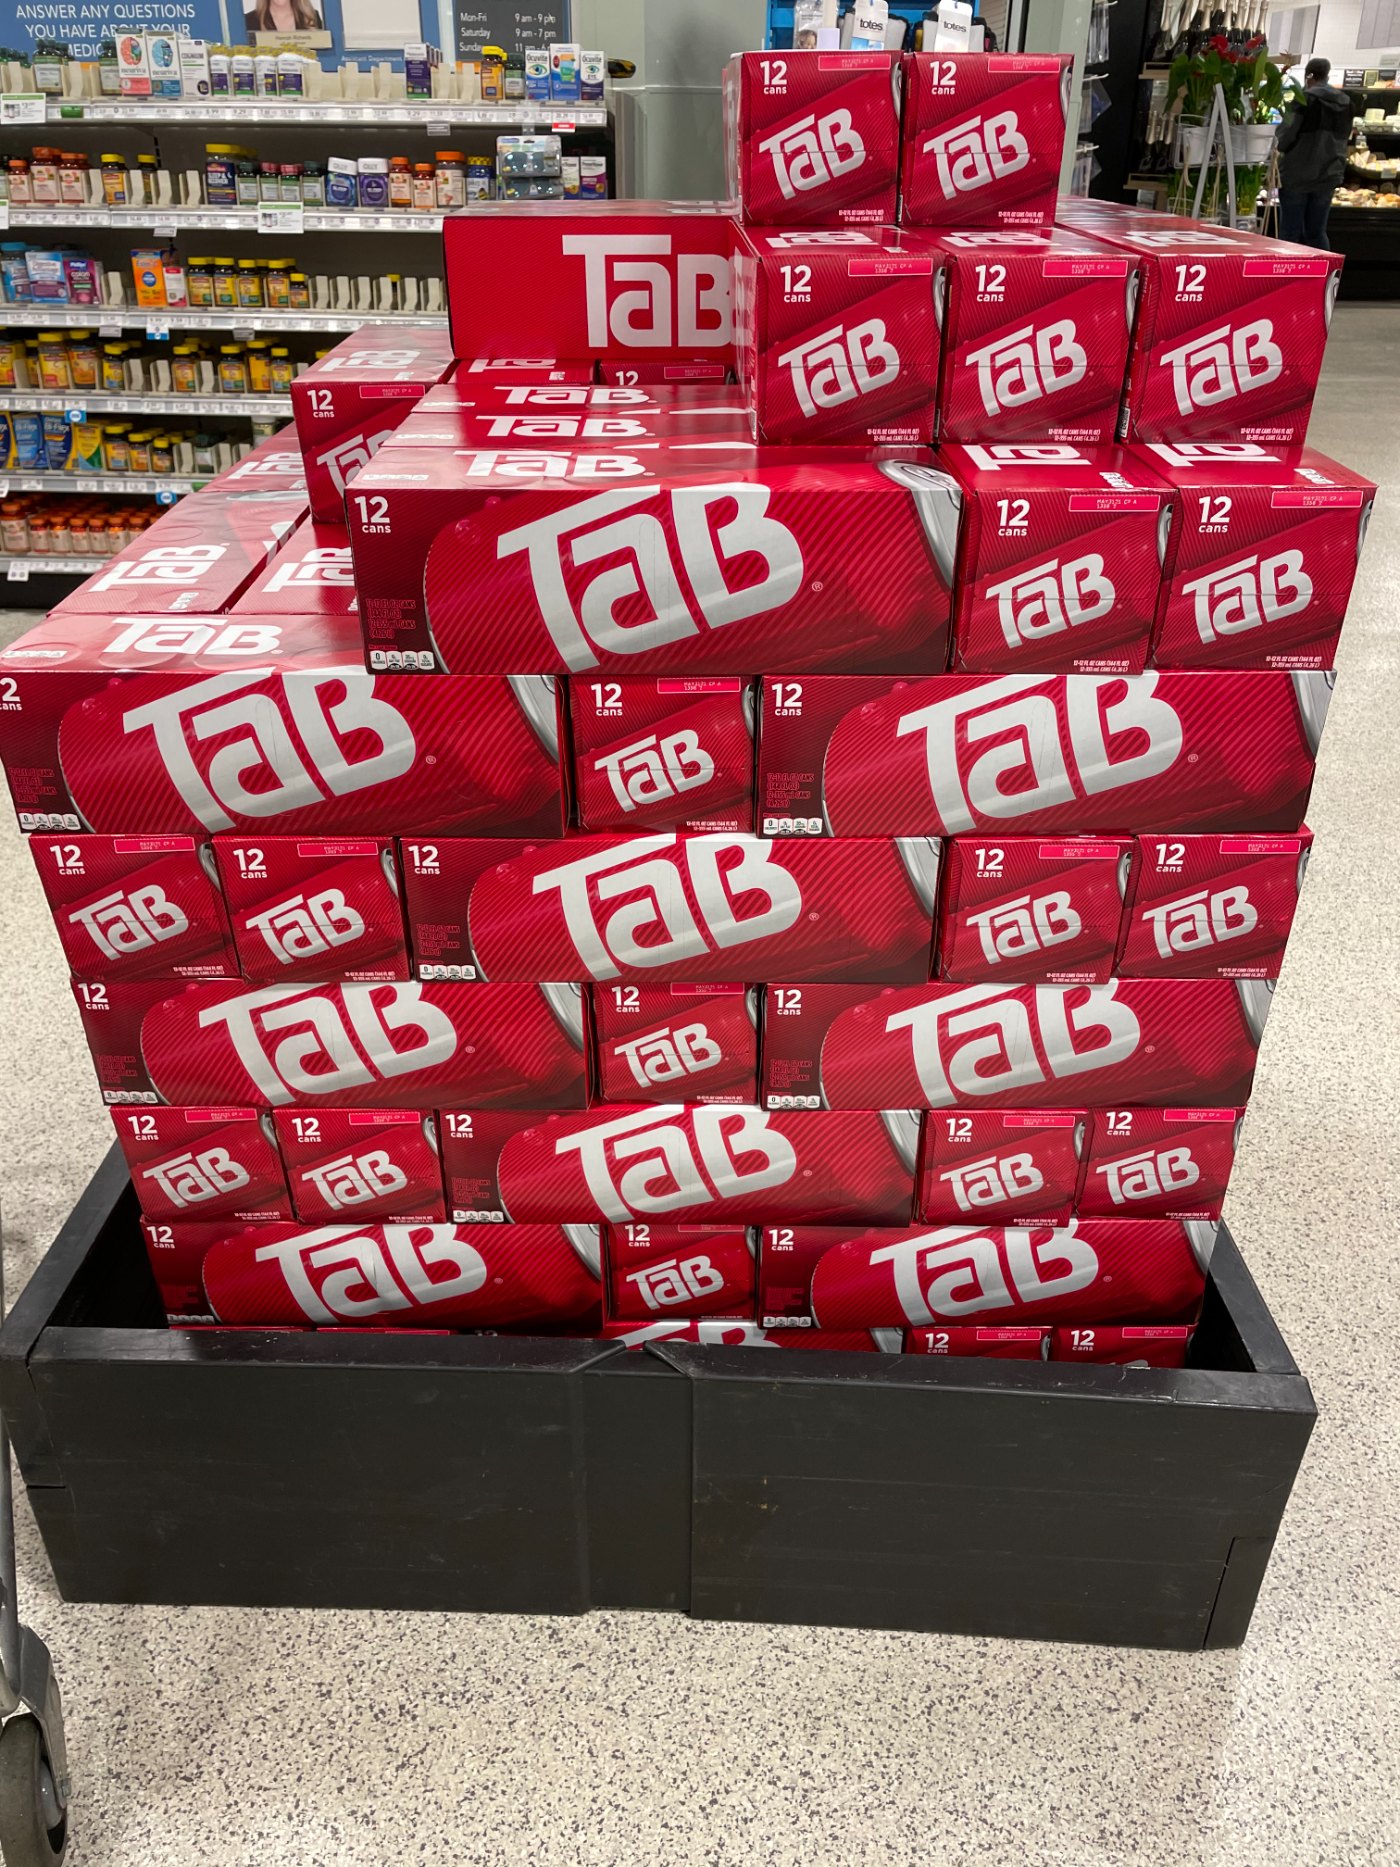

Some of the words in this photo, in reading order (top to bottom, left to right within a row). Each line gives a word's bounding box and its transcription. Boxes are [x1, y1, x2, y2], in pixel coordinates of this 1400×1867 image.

[16, 5, 77, 19] ANSWER
[80, 5, 109, 19] ANY
[114, 4, 196, 18] QUESTIONS
[460, 13, 488, 22] Mon-Fri
[514, 14, 521, 22] 9
[537, 14, 544, 23] 9
[25, 25, 56, 38] YOU
[60, 25, 97, 37] HAVE
[461, 28, 491, 39] Saturday
[515, 29, 521, 37] 9
[538, 29, 544, 38] 7
[544, 31, 556, 40] pm
[859, 18, 883, 31] totes
[943, 20, 967, 33] totes
[459, 42, 484, 52] Sunda
[514, 44, 523, 52] 11
[526, 54, 548, 63] Ocuvite
[582, 56, 602, 64] Ocuvite
[760, 61, 787, 85] 12
[930, 61, 956, 85] 12
[763, 86, 788, 95] cans
[931, 87, 956, 95] cans
[759, 109, 866, 199] TaB
[923, 111, 1030, 199] TaB
[781, 265, 811, 292] 12
[976, 265, 1006, 291] 12
[1176, 265, 1206, 291] 12
[562, 235, 738, 348] TaB
[783, 293, 811, 303] cans
[976, 293, 1004, 303] cans
[1174, 293, 1203, 302] cans
[778, 319, 900, 417] TaB
[966, 319, 1087, 416] TaB
[1160, 319, 1282, 416] TaB
[616, 371, 638, 385] 12
[307, 390, 333, 410] 12
[494, 387, 649, 404] TaB
[312, 410, 335, 418] cans
[476, 416, 647, 437] TaB
[453, 450, 645, 477] TaB
[962, 445, 1091, 470] Ta
[1126, 444, 1281, 466] Ta
[355, 496, 390, 523] 12
[997, 499, 1029, 526] 12
[1199, 496, 1231, 522] 12
[361, 524, 392, 534] cans
[997, 528, 1028, 537] cans
[1198, 524, 1229, 533] cans
[497, 482, 803, 673] TaB
[986, 554, 1115, 648] TaB
[1182, 550, 1313, 643] TaB
[103, 617, 282, 655] TaB
[0, 678, 20, 701] 2
[591, 684, 622, 707] 12
[772, 683, 802, 707] 12
[595, 708, 623, 717] cans
[774, 708, 802, 717] cans
[123, 666, 416, 833] TaB
[896, 670, 1183, 835] TaB
[595, 730, 714, 812] TaB
[50, 845, 83, 867] 12
[233, 849, 266, 870] 12
[408, 846, 439, 866] 12
[976, 849, 1004, 870] 12
[1156, 844, 1185, 864] 12
[58, 867, 86, 876] cans
[240, 871, 268, 879] cans
[414, 867, 441, 875] cans
[1155, 865, 1182, 873] cans
[533, 833, 802, 981] TaB
[69, 885, 188, 960] TaB
[246, 889, 365, 964] TaB
[966, 891, 1081, 964] TaB
[1142, 886, 1258, 958] TaB
[78, 984, 108, 1002] 12
[612, 986, 639, 1005] 12
[775, 990, 801, 1008] 12
[776, 1008, 802, 1016] cans
[199, 980, 457, 1105] TaB
[885, 978, 1140, 1107] TaB
[615, 1023, 721, 1087] TaB
[128, 1116, 157, 1134] 12
[292, 1118, 320, 1136] 12
[446, 1114, 472, 1132] 12
[947, 1119, 972, 1136] 12
[1107, 1112, 1132, 1129] 12
[450, 1131, 474, 1139] cans
[556, 1104, 796, 1223] TaB
[143, 1148, 249, 1207] TaB
[302, 1150, 407, 1209] TaB
[940, 1153, 1043, 1211] TaB
[1096, 1147, 1199, 1204] TaB
[147, 1226, 173, 1242] 12
[625, 1225, 650, 1241] 12
[769, 1229, 793, 1245] 12
[256, 1223, 487, 1323] TaB
[870, 1219, 1099, 1325] TaB
[626, 1256, 724, 1309] TaB
[926, 1333, 949, 1348] 12
[1071, 1330, 1094, 1345] 12
